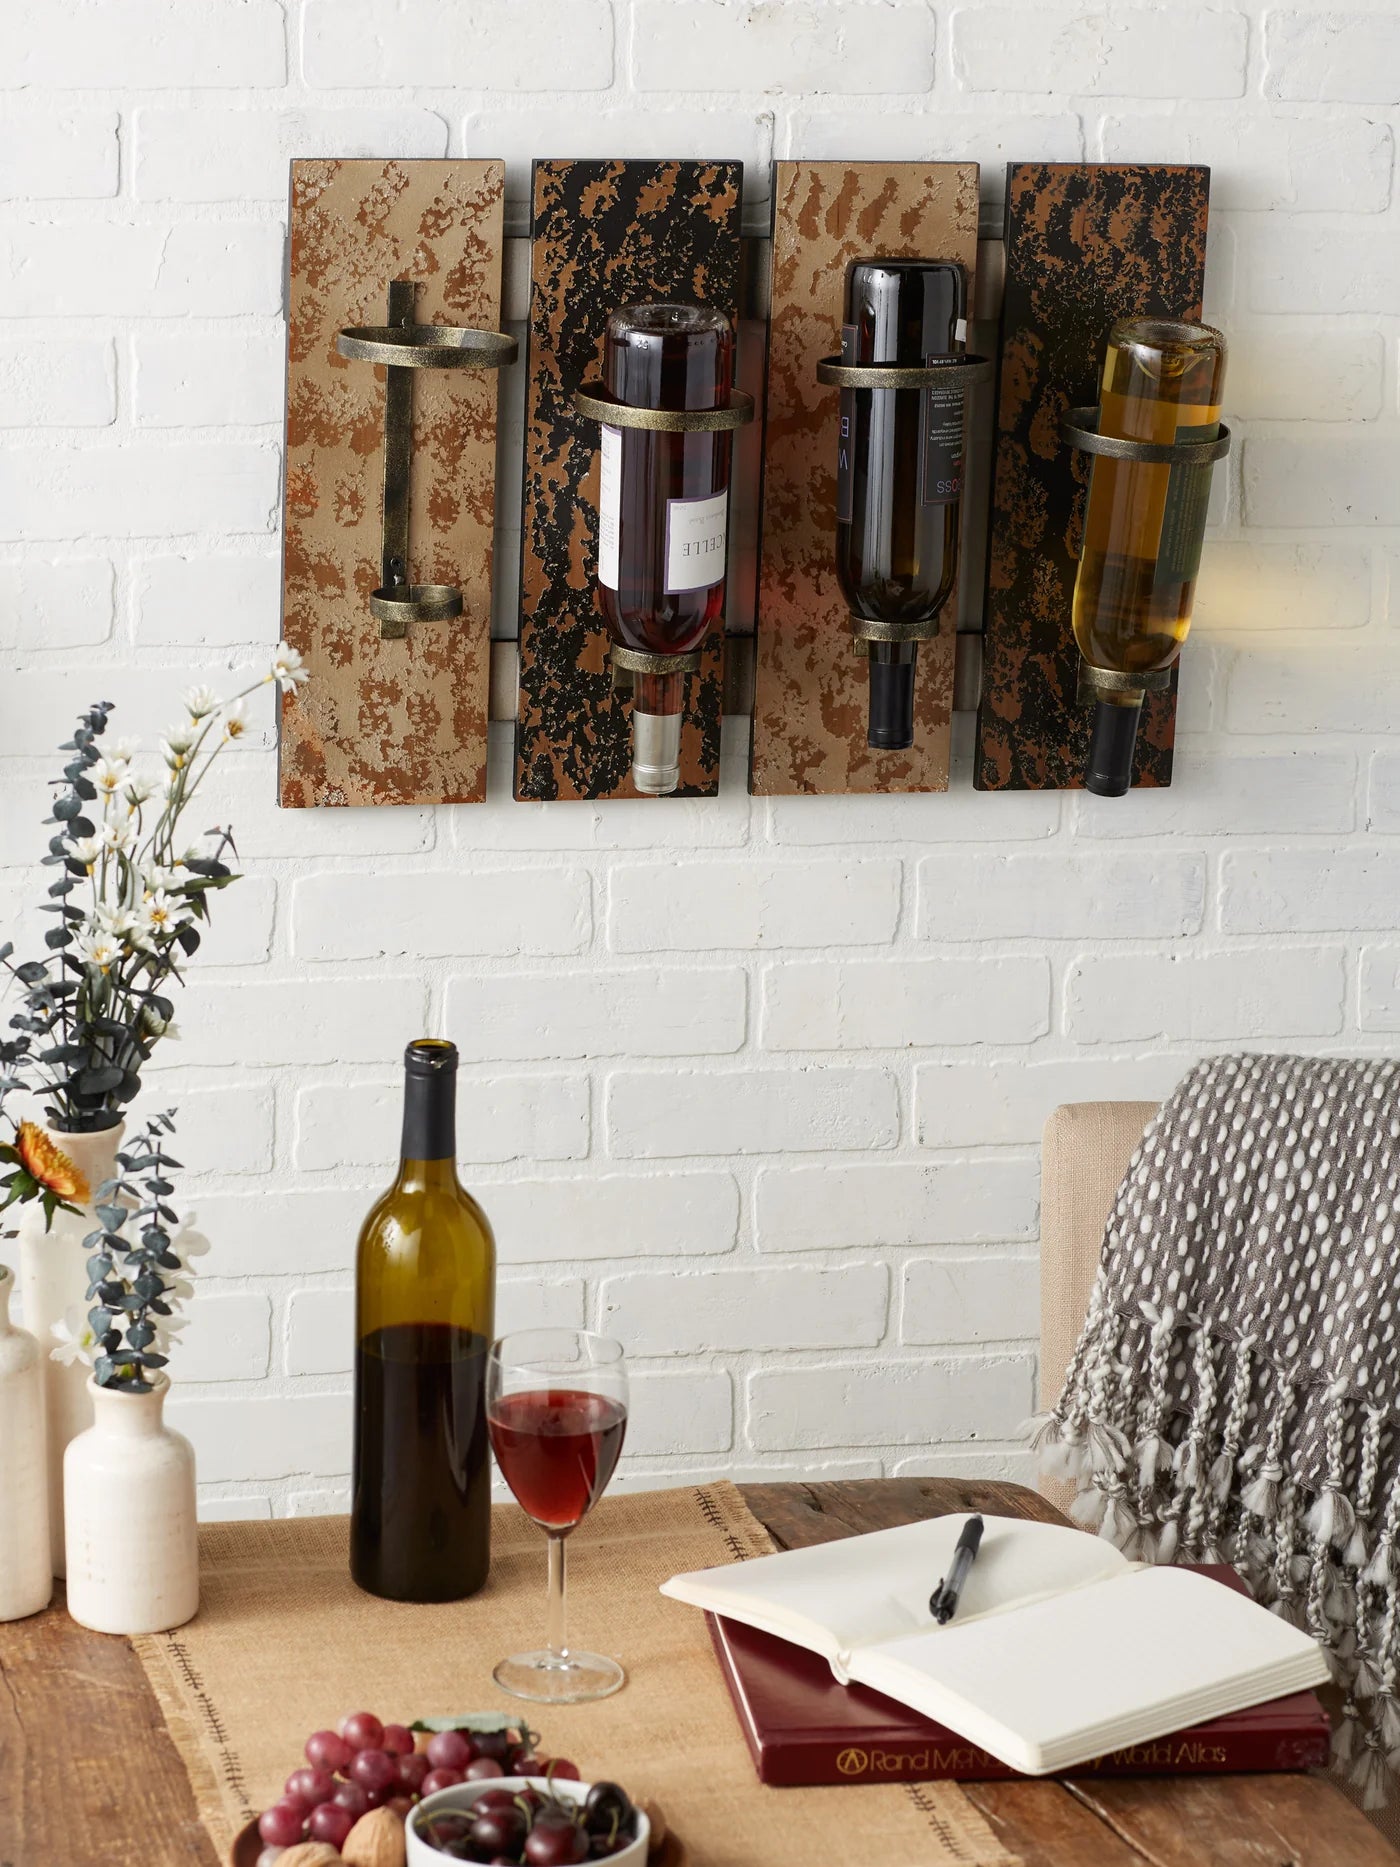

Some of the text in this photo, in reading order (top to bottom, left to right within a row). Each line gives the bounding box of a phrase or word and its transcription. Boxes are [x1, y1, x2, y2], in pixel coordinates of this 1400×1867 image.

[936, 478, 961, 494] OSS
[682, 532, 726, 557] CELLE
[870, 1748, 929, 1771] Rand
